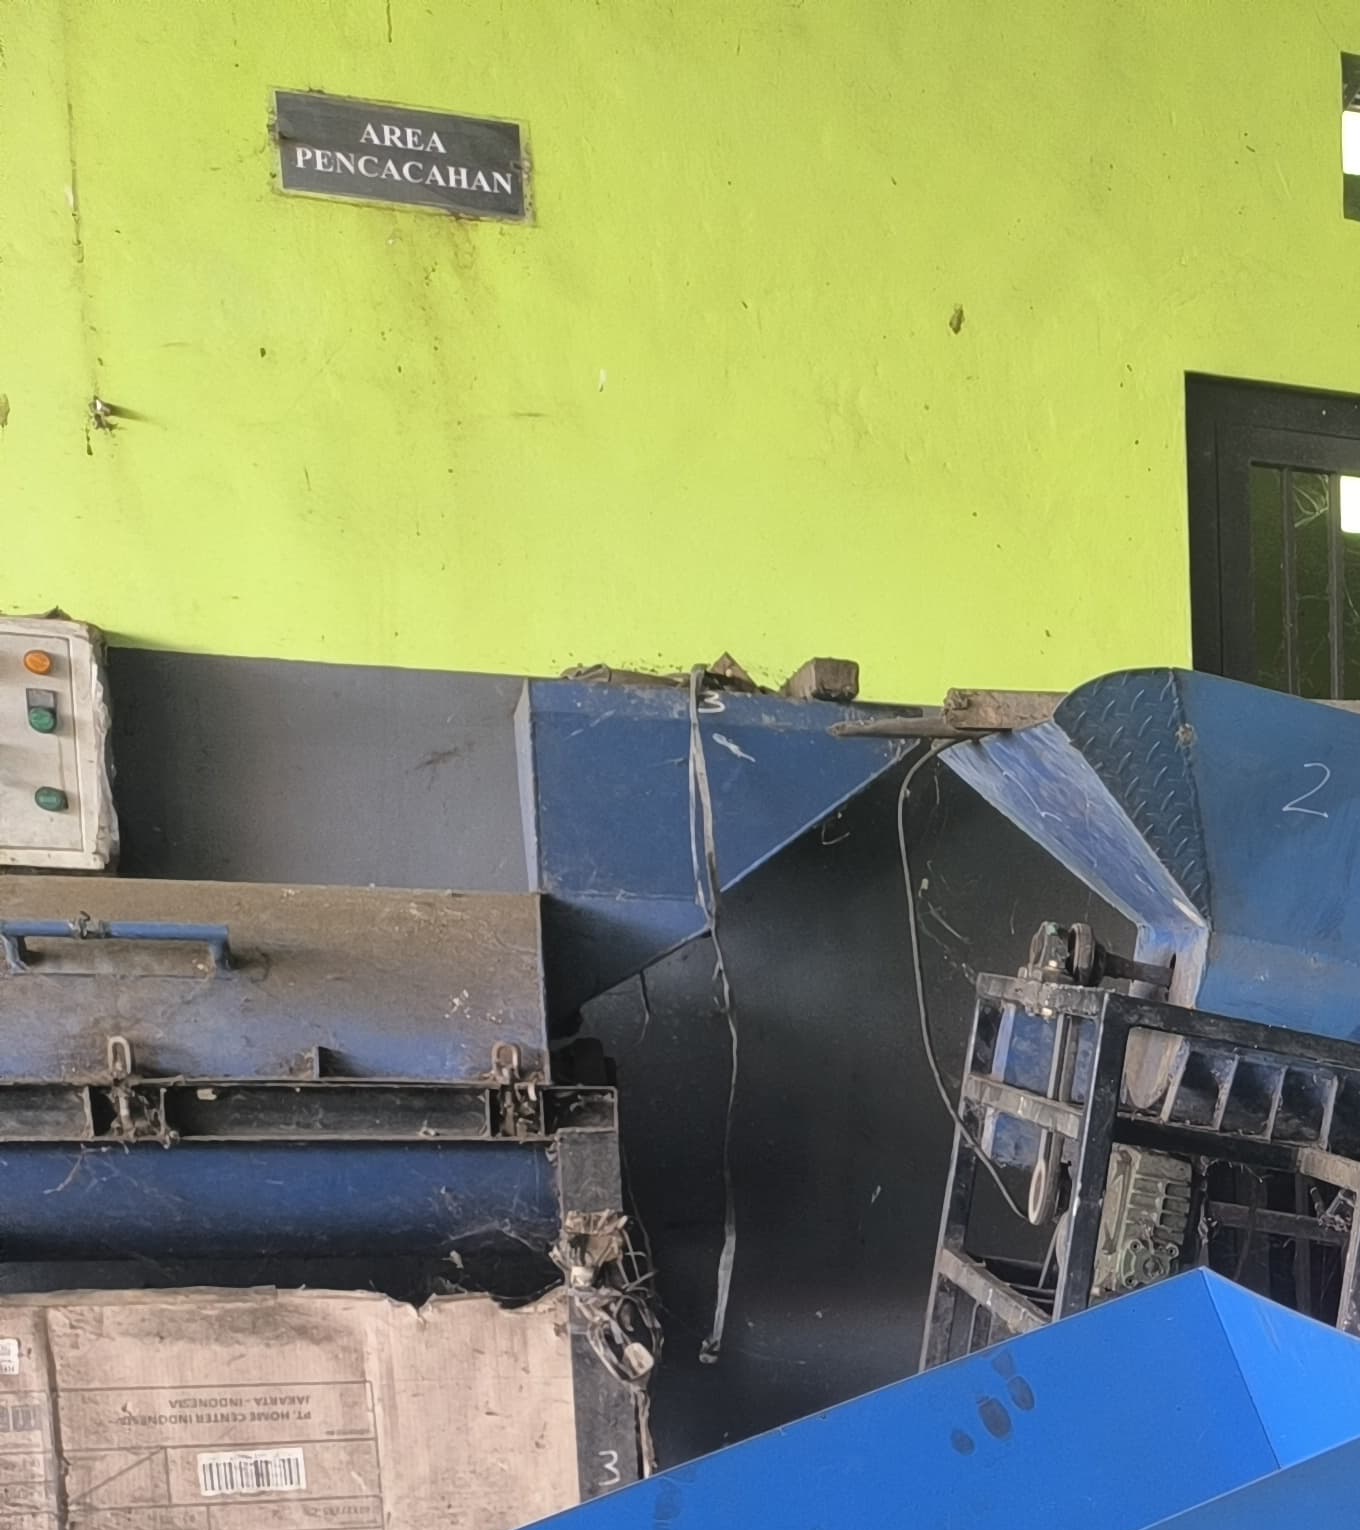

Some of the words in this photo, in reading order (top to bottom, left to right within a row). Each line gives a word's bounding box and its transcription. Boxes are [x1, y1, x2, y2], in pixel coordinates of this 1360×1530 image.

[360, 122, 447, 154] AREA
[295, 147, 513, 195] PENCACAHAN
[1282, 762, 1330, 818] 2
[168, 1397, 243, 1409] INDONESIA
[253, 1395, 311, 1407] JAKARTA
[196, 1411, 247, 1424] CENTER
[250, 1411, 290, 1422] HOME
[292, 1410, 311, 1421] PT.
[597, 1449, 621, 1486] 3
